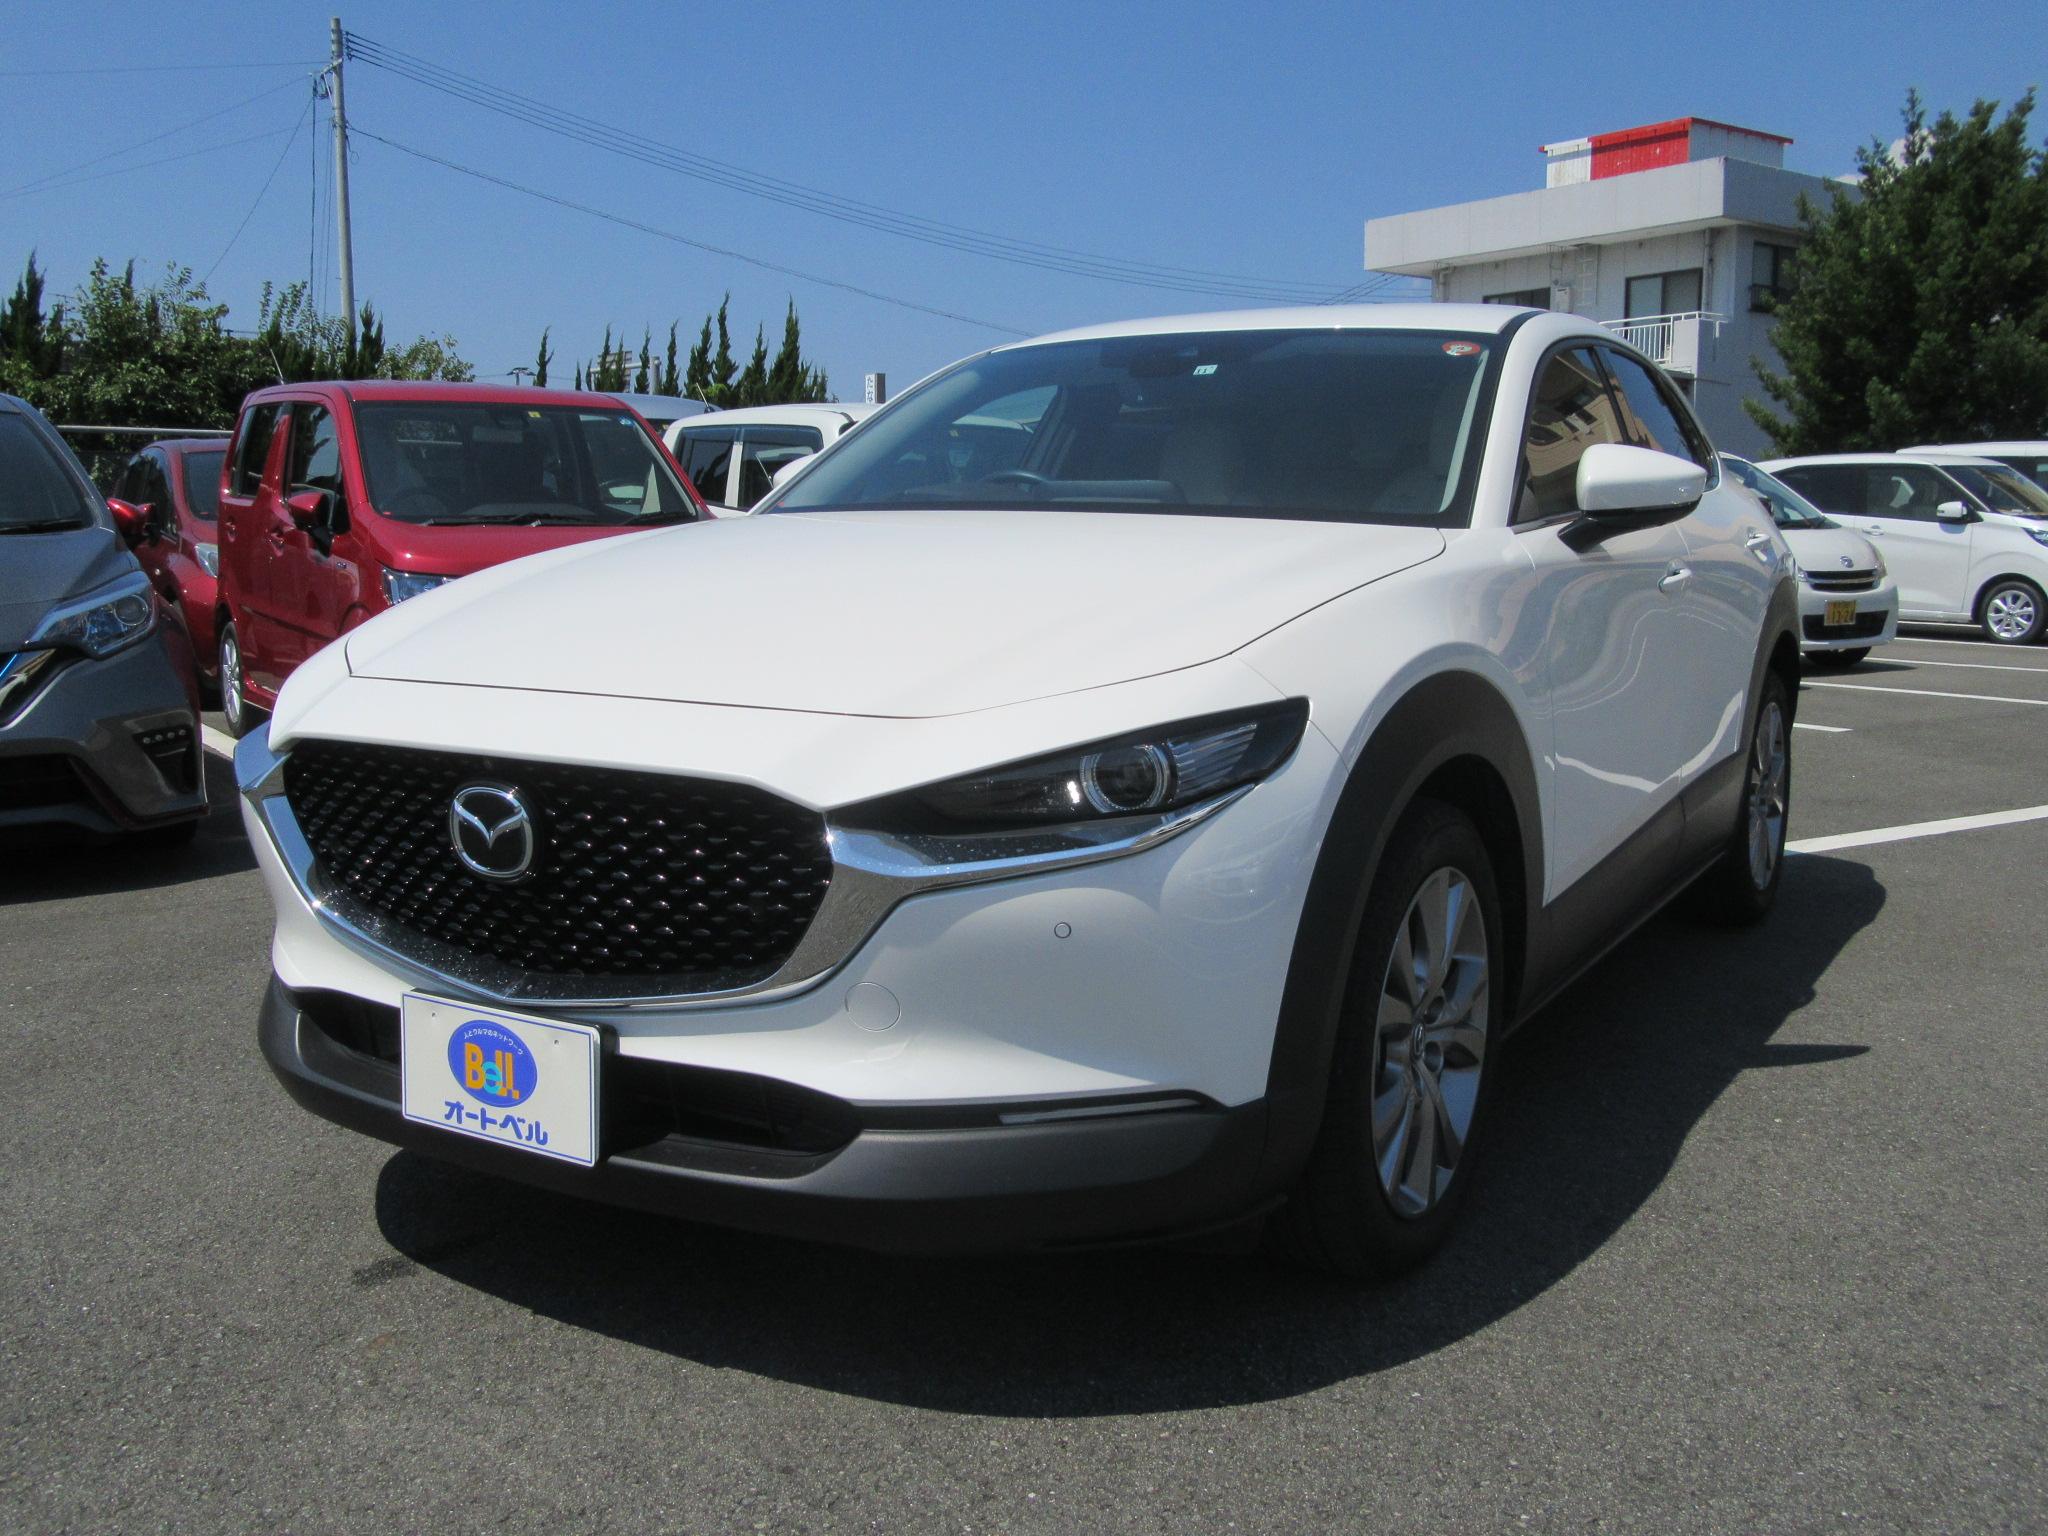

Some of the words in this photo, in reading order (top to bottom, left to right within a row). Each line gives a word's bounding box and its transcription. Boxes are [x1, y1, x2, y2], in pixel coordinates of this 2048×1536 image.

[444, 1101, 549, 1145] オートベル
